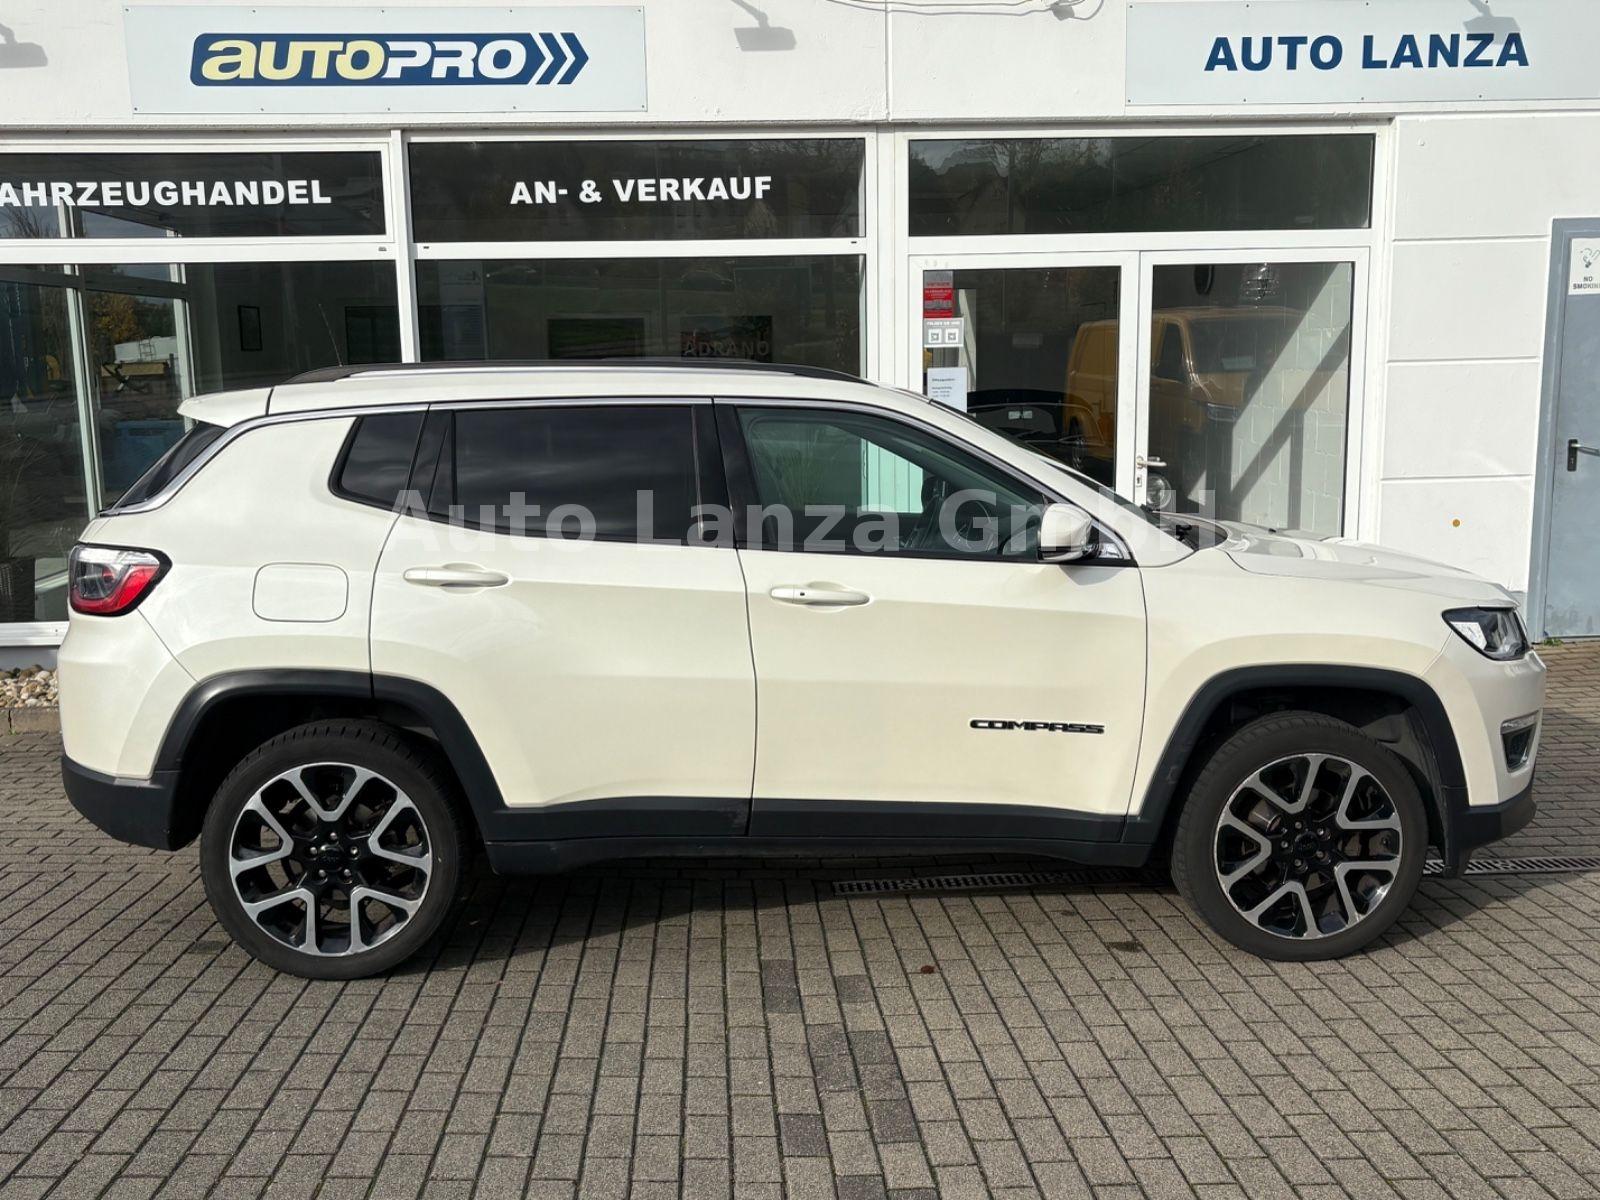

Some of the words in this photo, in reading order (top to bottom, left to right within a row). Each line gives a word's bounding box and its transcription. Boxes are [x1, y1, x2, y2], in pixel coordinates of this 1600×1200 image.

[1204, 35, 1343, 71] AUTO
[1361, 32, 1529, 69] LANZA
[510, 181, 567, 204] AN-
[578, 180, 602, 204] &
[612, 176, 771, 202] VERKAUF
[685, 340, 769, 357] ADRANO
[969, 719, 1105, 734] COMPASS
